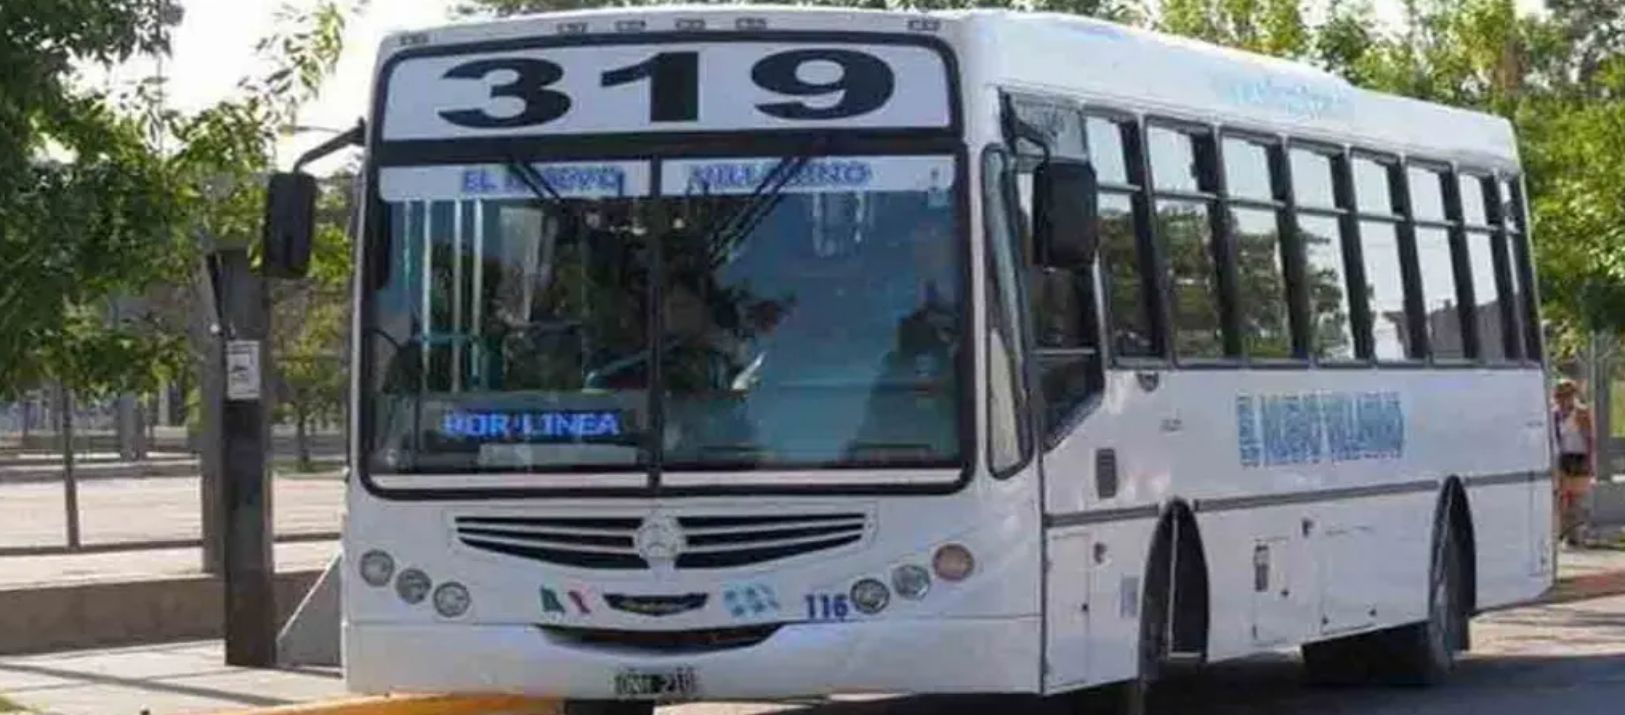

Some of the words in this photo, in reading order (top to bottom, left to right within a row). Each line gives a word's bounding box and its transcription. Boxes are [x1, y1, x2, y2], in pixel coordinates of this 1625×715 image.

[437, 48, 896, 128] 319
[522, 412, 620, 437] LINEA
[804, 594, 849, 620] 116
